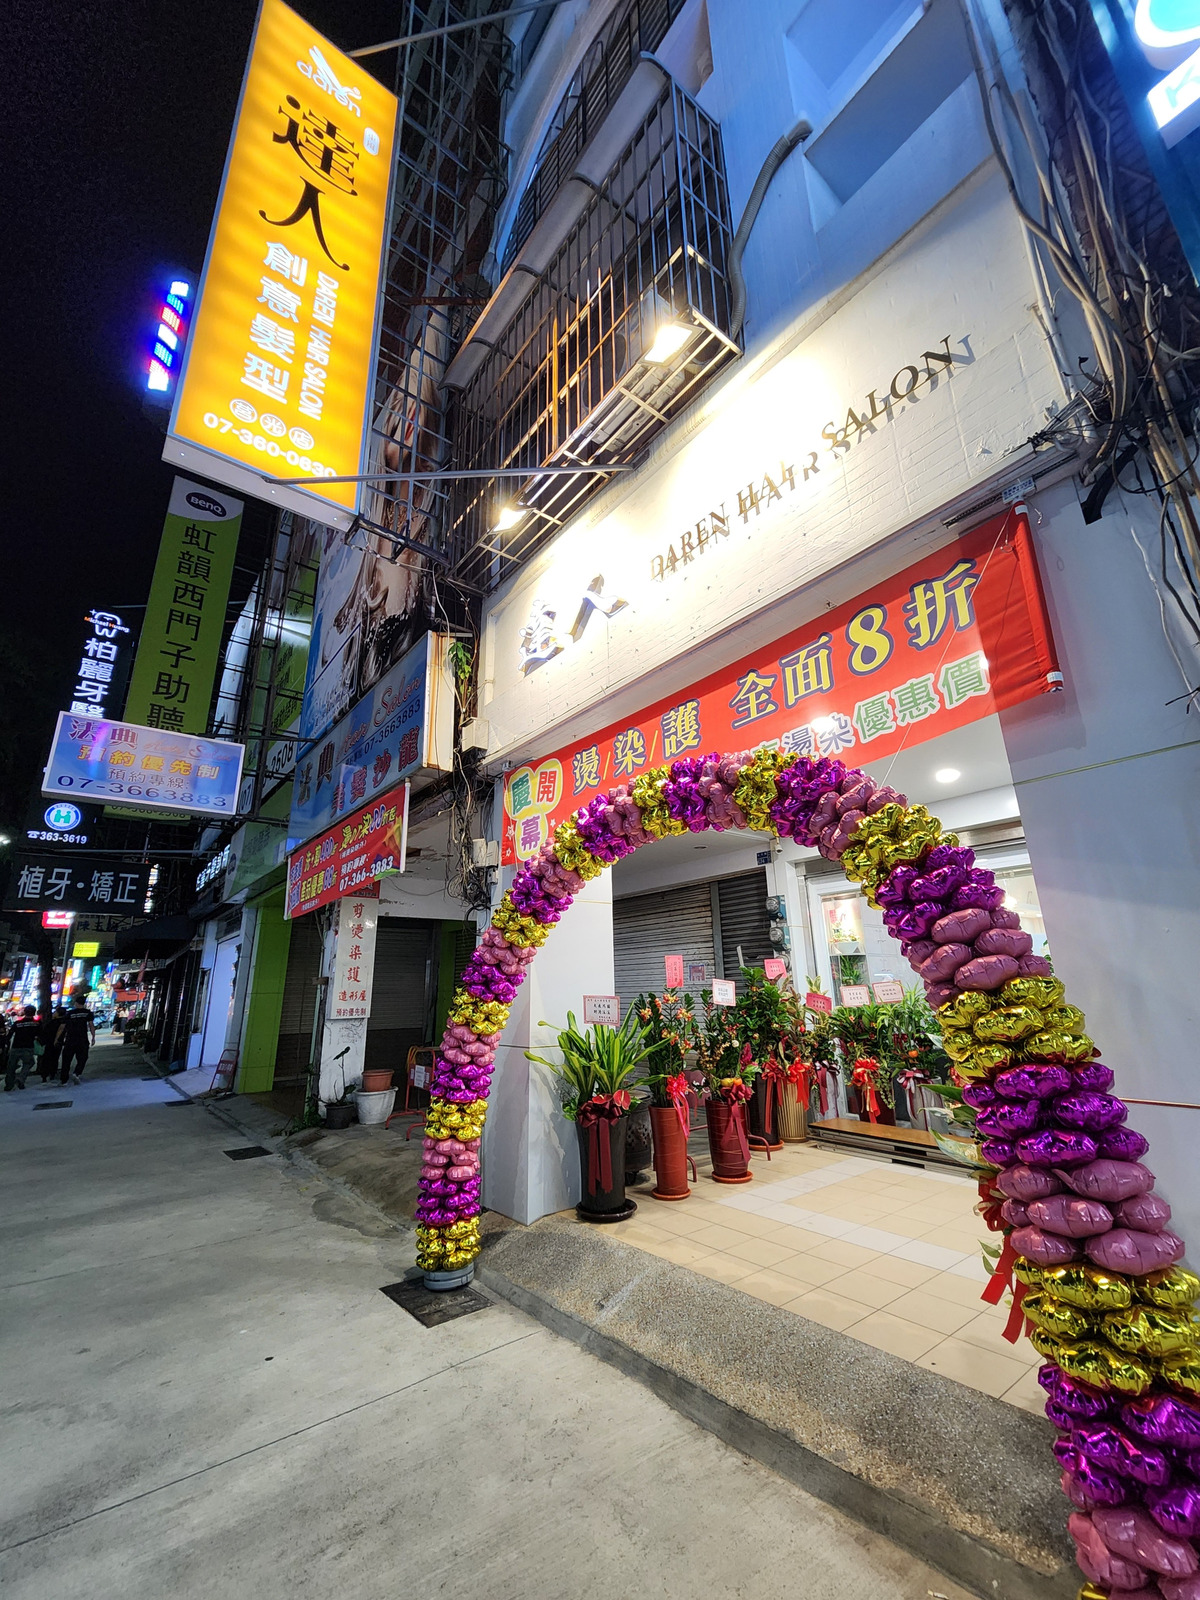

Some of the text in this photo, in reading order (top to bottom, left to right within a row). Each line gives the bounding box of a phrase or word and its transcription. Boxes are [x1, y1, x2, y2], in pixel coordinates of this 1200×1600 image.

[258, 95, 359, 270] 達人
[240, 242, 308, 404] 創意髮型
[298, 271, 339, 421] DAREN HAIR SALON
[651, 502, 727, 580] DAREN
[822, 334, 952, 451] SALON
[190, 496, 223, 515] BenQ
[84, 616, 130, 633] Michael Huang
[730, 559, 980, 729] 全面8折
[364, 699, 420, 754] 07-3663883
[374, 674, 424, 727] Salon
[77, 746, 220, 780] 預約優先制
[57, 775, 226, 807] 07-3663883
[39, 831, 87, 844] 363-3619
[340, 855, 394, 891] 07-366-3883
[347, 902, 365, 983] 剪燙染護
